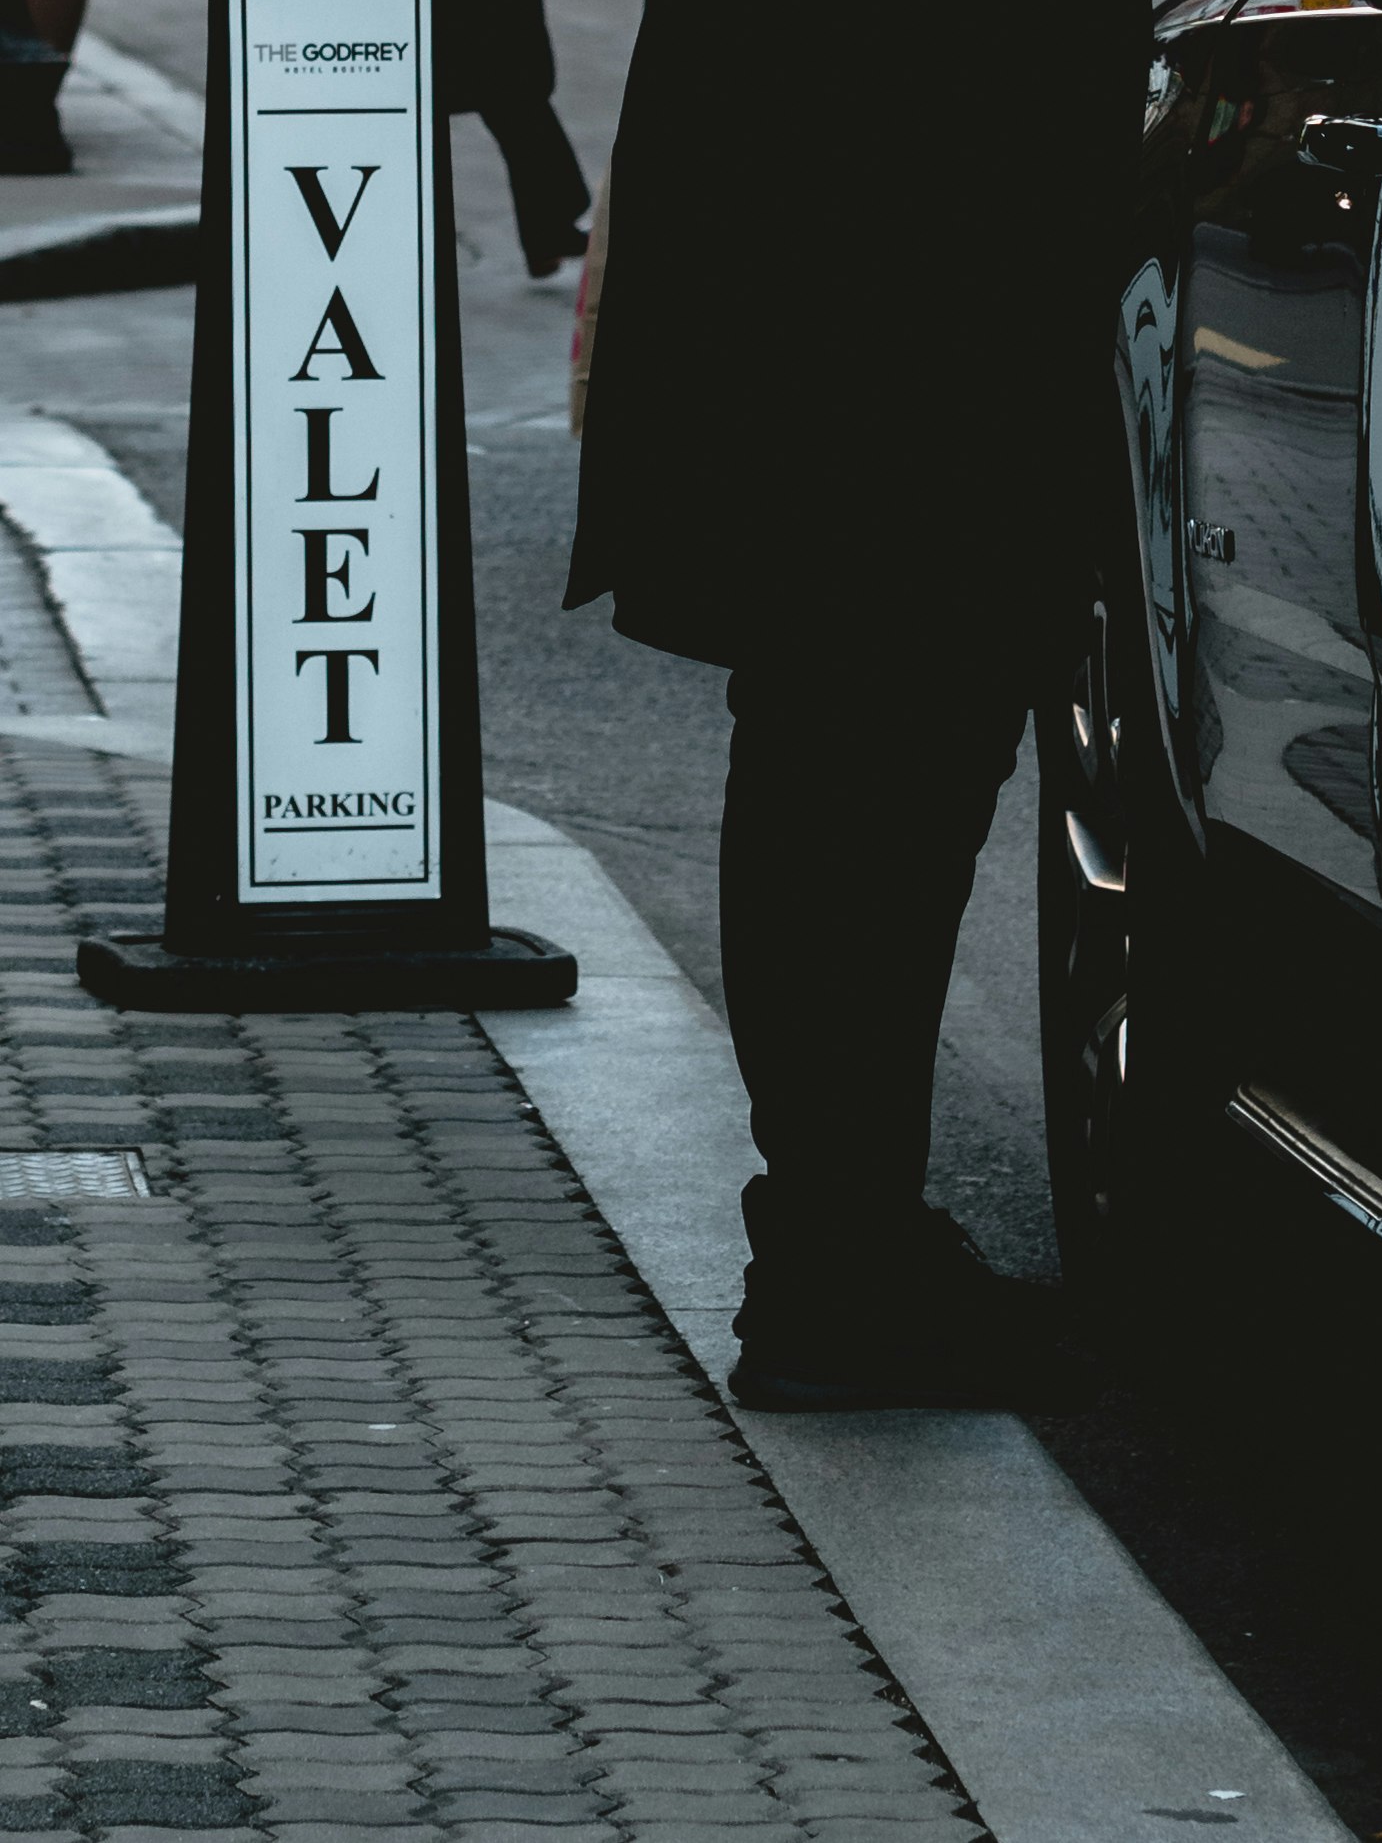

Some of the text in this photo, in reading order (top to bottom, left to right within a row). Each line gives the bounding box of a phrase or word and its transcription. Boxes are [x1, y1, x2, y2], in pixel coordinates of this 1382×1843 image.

[254, 42, 408, 62] THE GODFREY
[284, 65, 380, 74] HOTEL BOSTON
[283, 165, 386, 745] VALET
[263, 791, 416, 819] PARKING
